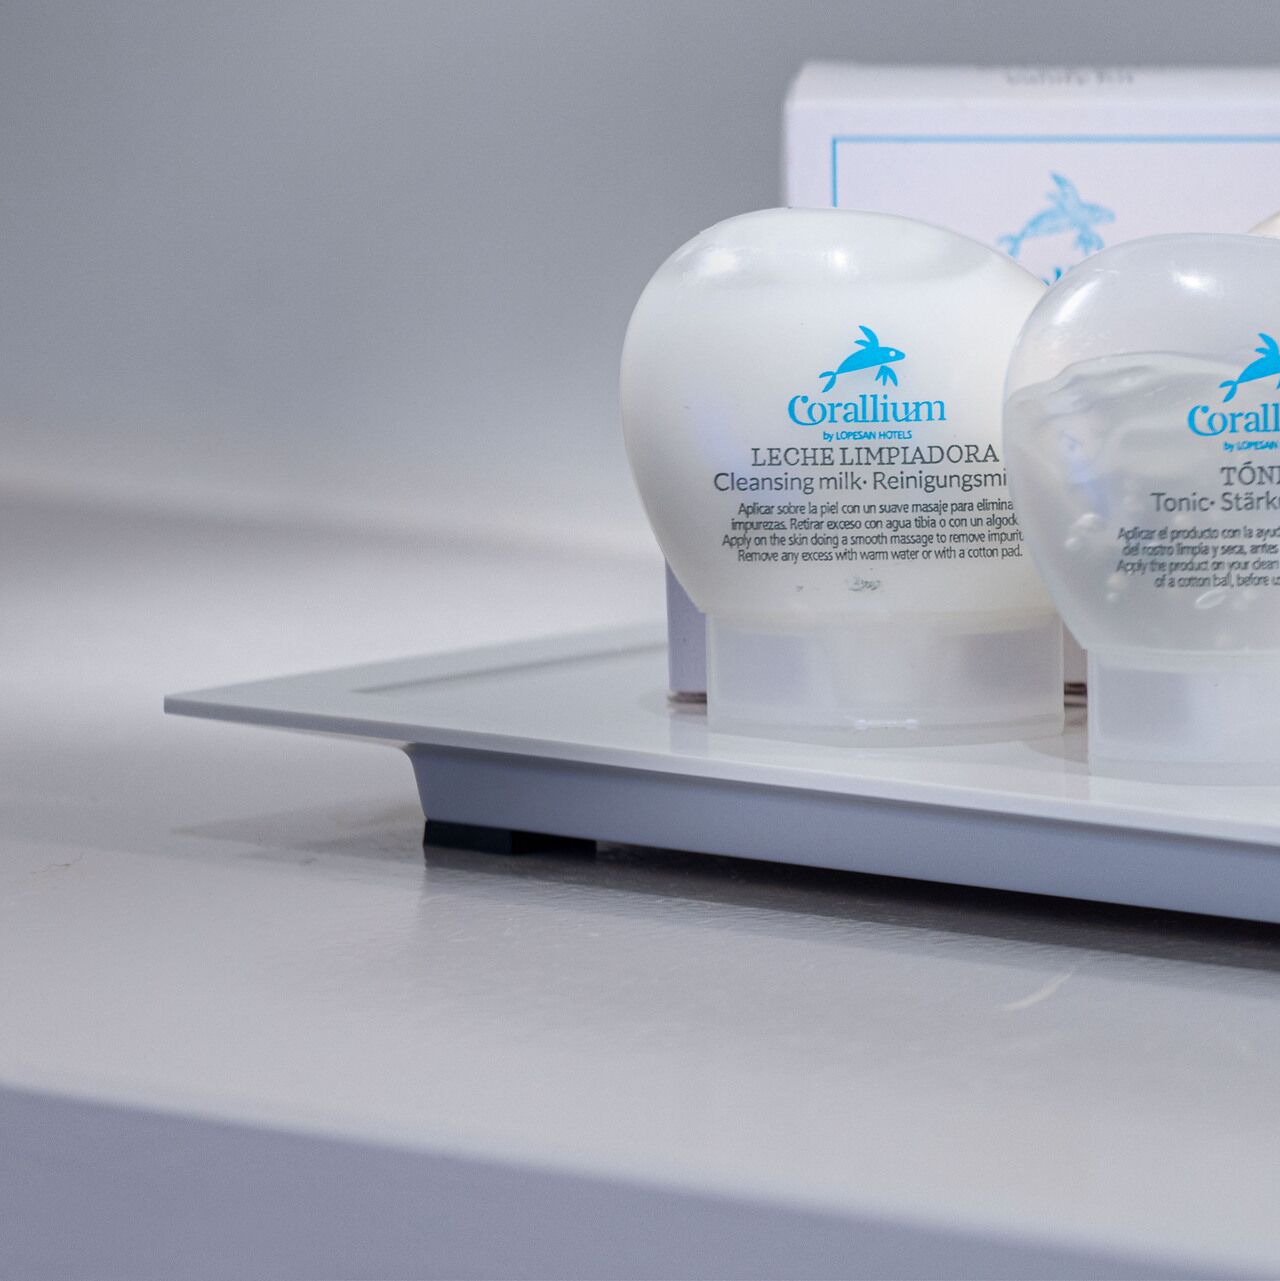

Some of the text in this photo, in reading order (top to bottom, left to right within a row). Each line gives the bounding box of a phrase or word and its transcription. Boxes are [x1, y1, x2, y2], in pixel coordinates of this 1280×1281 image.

[787, 394, 946, 426] Corallium
[823, 431, 912, 442] by LOPESAN HOTELS
[752, 444, 999, 466] LECHE LIMPIADORA
[714, 473, 814, 494] Cleansing
[873, 469, 1007, 492] Reinigungsmi
[738, 502, 775, 518] Aplicar
[778, 502, 805, 515] sobre
[809, 502, 817, 514] la
[821, 501, 838, 517] piel
[842, 504, 859, 514] con
[864, 503, 876, 513] un
[879, 503, 909, 513] suave
[912, 500, 948, 515] masaje
[951, 502, 973, 514] para
[790, 518, 824, 530] Retirar
[827, 520, 861, 529] exceso
[865, 519, 882, 528] con
[886, 519, 911, 532] agua
[915, 516, 936, 528] tibia
[939, 519, 946, 527] o
[949, 518, 967, 527] con
[970, 518, 983, 526] un
[722, 534, 751, 549] Apply
[755, 536, 767, 545] on
[770, 534, 786, 545] the
[788, 534, 808, 545] skin
[811, 534, 839, 548] doing
[842, 536, 847, 544] a
[851, 533, 887, 544] smooth
[891, 534, 933, 547] massage
[936, 534, 946, 543] to
[949, 533, 985, 543] remove
[738, 544, 1022, 564] Remove any excess with warm water or with a cotton pad.
